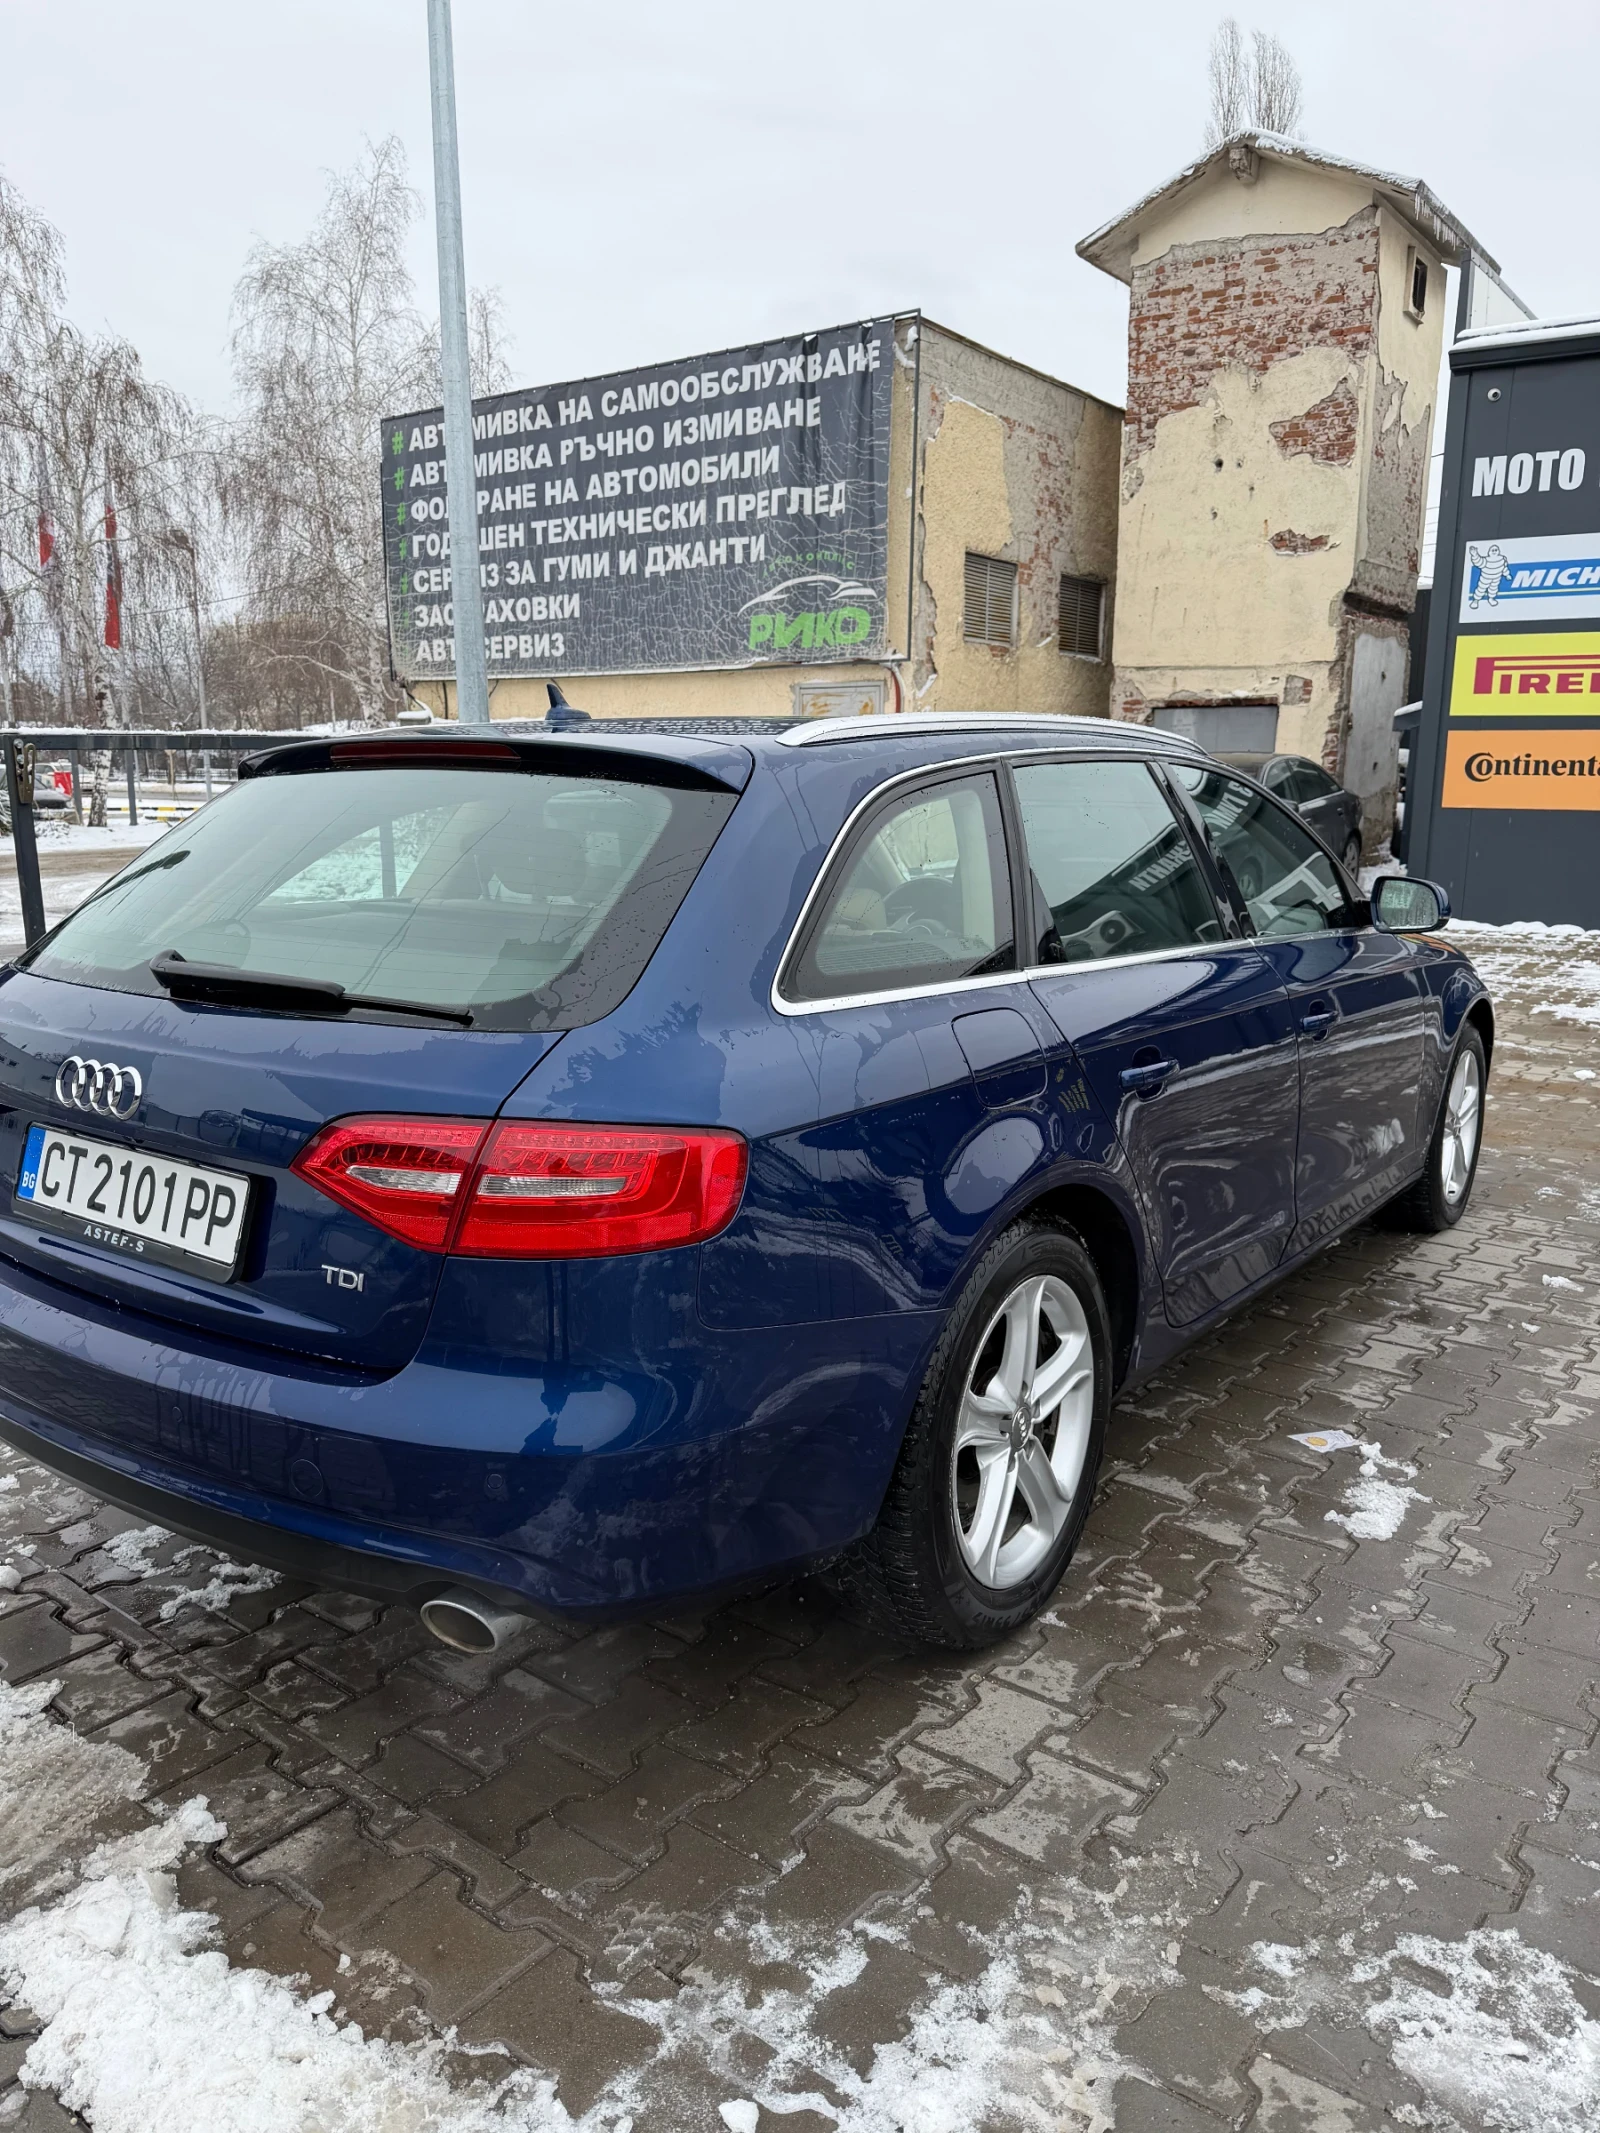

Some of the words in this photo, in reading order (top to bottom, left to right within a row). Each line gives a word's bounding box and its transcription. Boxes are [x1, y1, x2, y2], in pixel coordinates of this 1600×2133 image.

[409, 404, 553, 452] АВТМИВКА
[558, 395, 593, 426] НА
[601, 340, 881, 417] САМООБСЛУЖВАНЕ
[409, 443, 554, 488] АВТМИВКА
[560, 425, 654, 465] РЪЧНО
[663, 396, 821, 448] ИЗМИВАНЕ
[411, 483, 537, 522] ФОРАНЕ
[545, 478, 579, 506] НА
[585, 445, 780, 500] АВТОМОБИЛИ
[412, 523, 525, 560] ГОДШЕН
[531, 500, 707, 545] ТЕХНИЧЕСКИ
[716, 481, 846, 523] ПРЕГЛЕД
[413, 562, 499, 594] СЕРЗ
[505, 560, 536, 585] ЗА
[543, 551, 610, 582] ГУМИ
[619, 549, 637, 576] И
[645, 534, 765, 578] ДЖАНТИ
[414, 593, 580, 628] ЗАСАХОВКИ
[748, 606, 872, 650] РИКО
[415, 632, 565, 662] АВТЕРВИЗ
[1464, 752, 1600, 782] Continent
[22, 1171, 36, 1189] BG
[321, 1264, 366, 1292] TDI
